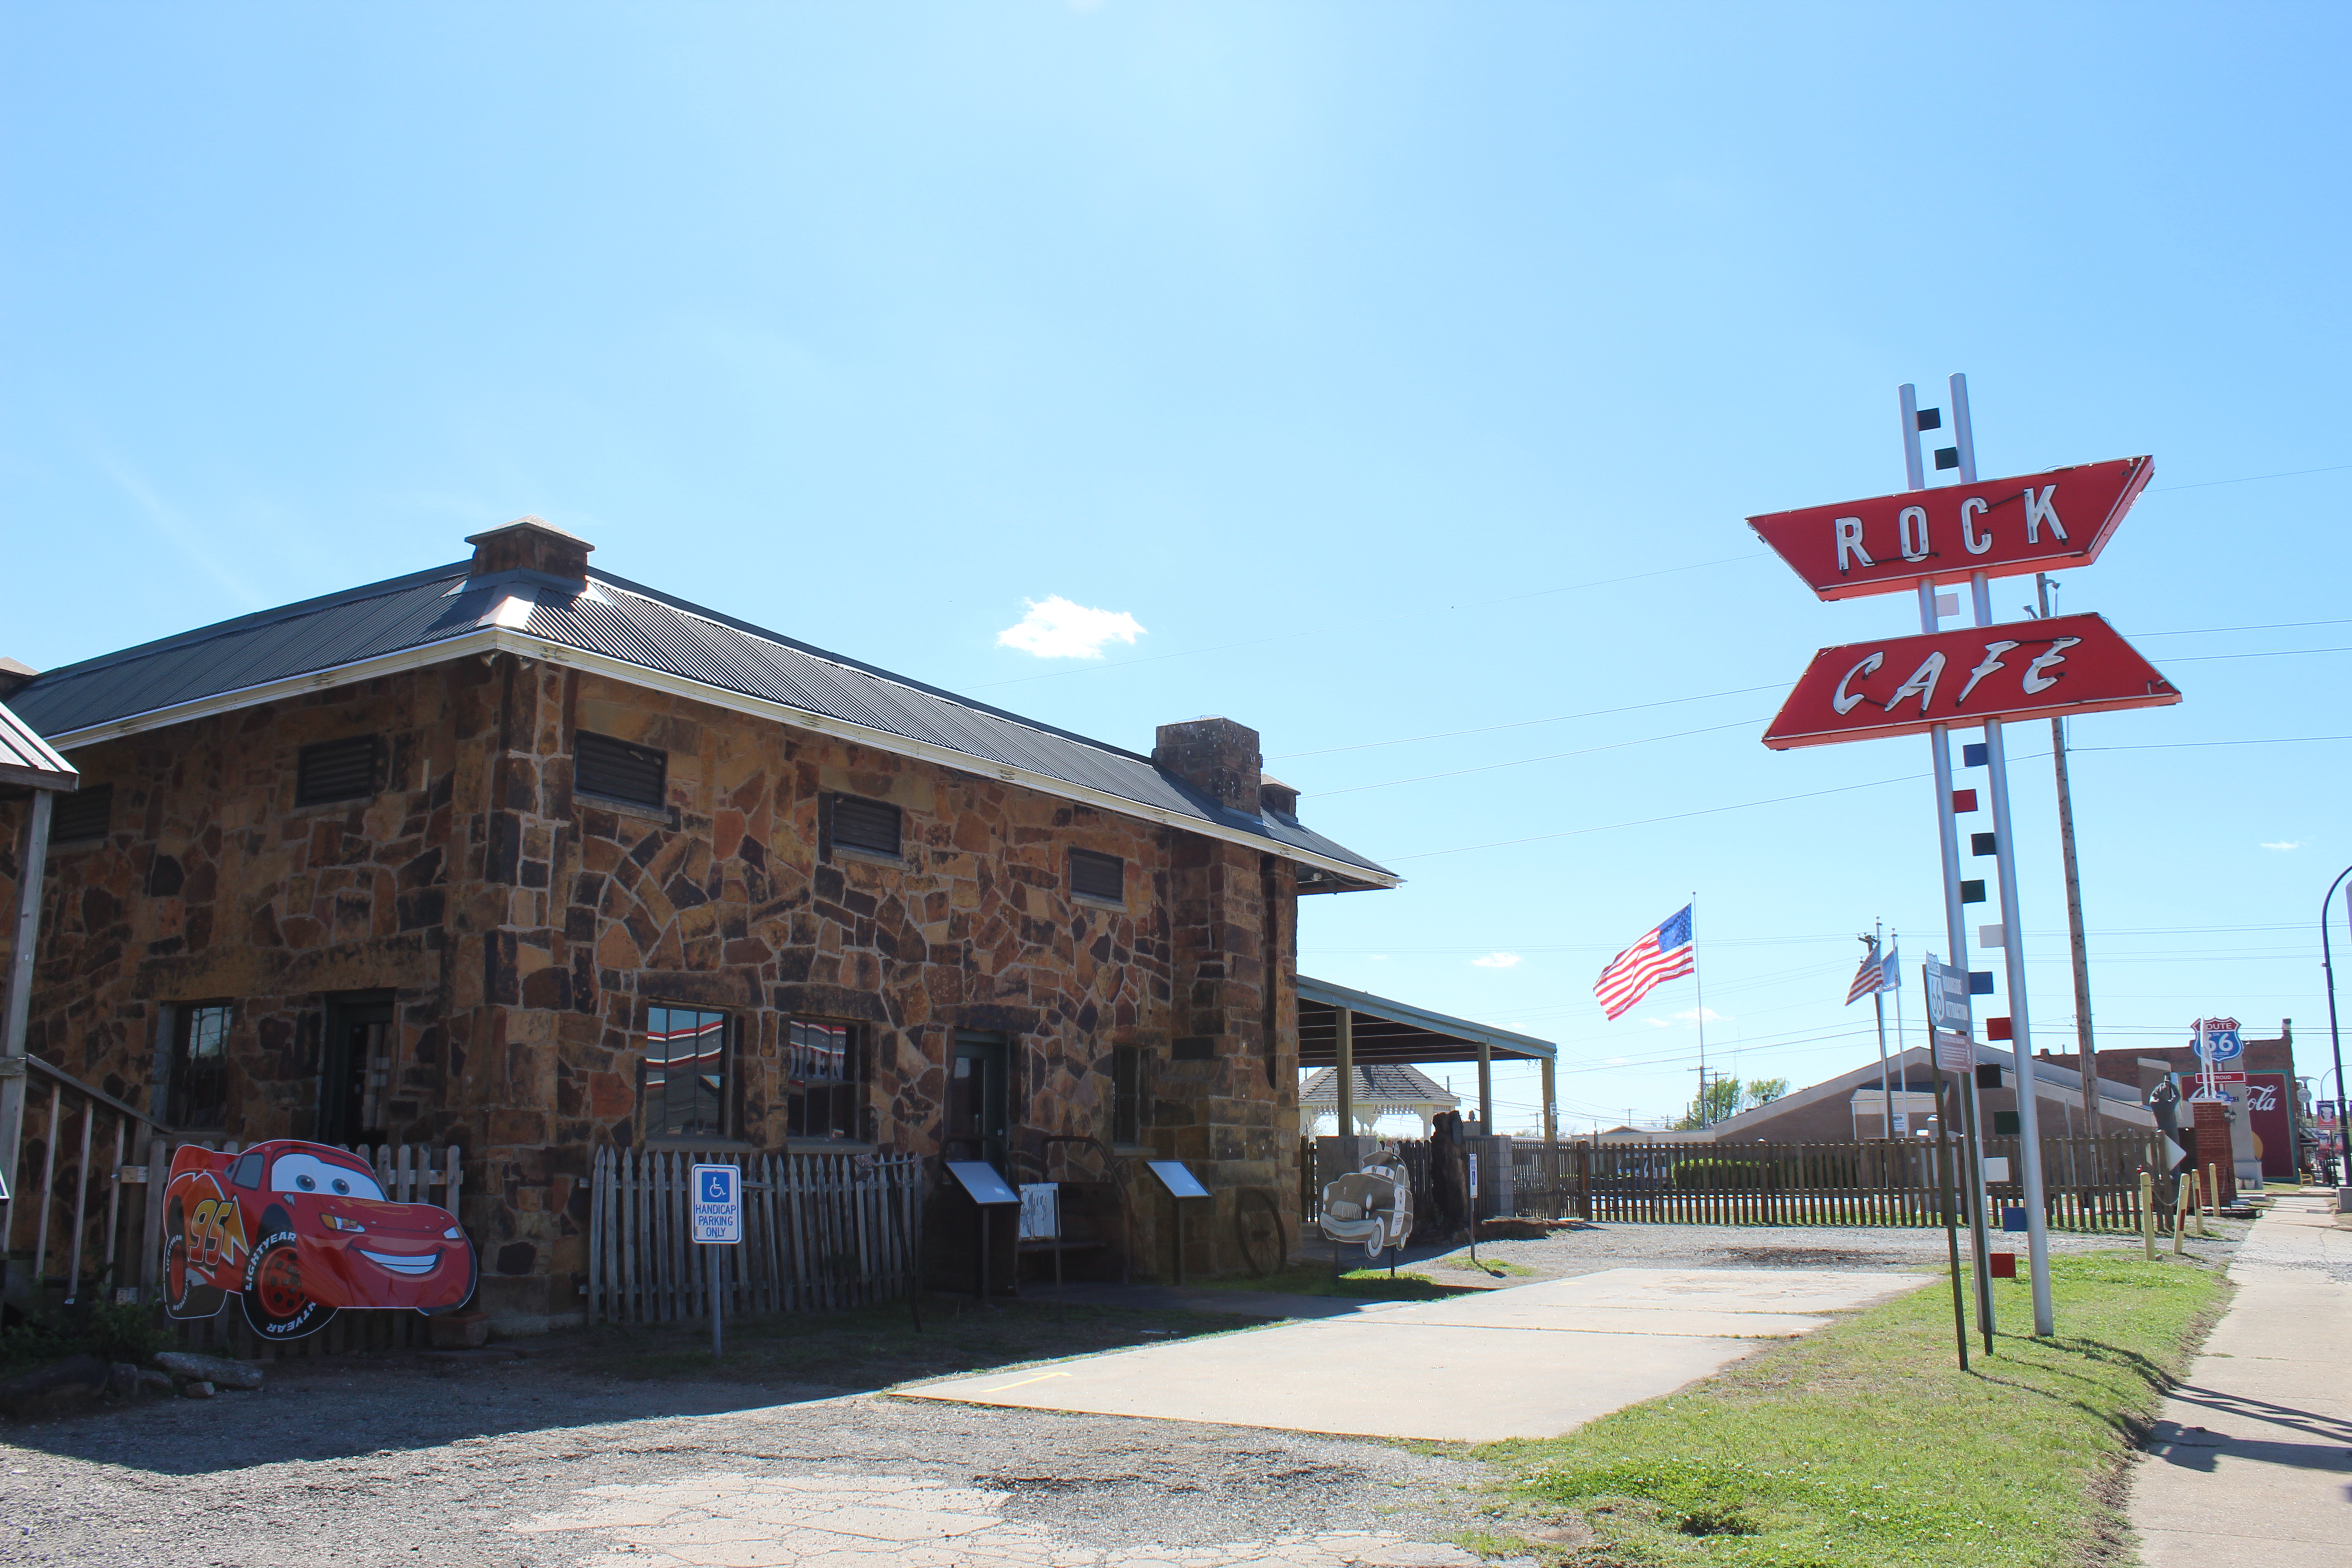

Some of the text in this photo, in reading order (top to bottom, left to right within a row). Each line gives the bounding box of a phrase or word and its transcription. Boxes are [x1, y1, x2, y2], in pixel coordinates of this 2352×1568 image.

[1834, 484, 2068, 572] ROCK
[1833, 636, 2082, 715] CAFE
[1931, 977, 1942, 1016] 66
[696, 1204, 736, 1215] HANDICAP
[699, 1216, 733, 1226] PARKING
[189, 1199, 233, 1266] 95
[706, 1227, 726, 1237] ONLY
[245, 1231, 297, 1291] LIGHTYEAR
[266, 1301, 317, 1333] HTYEAR
